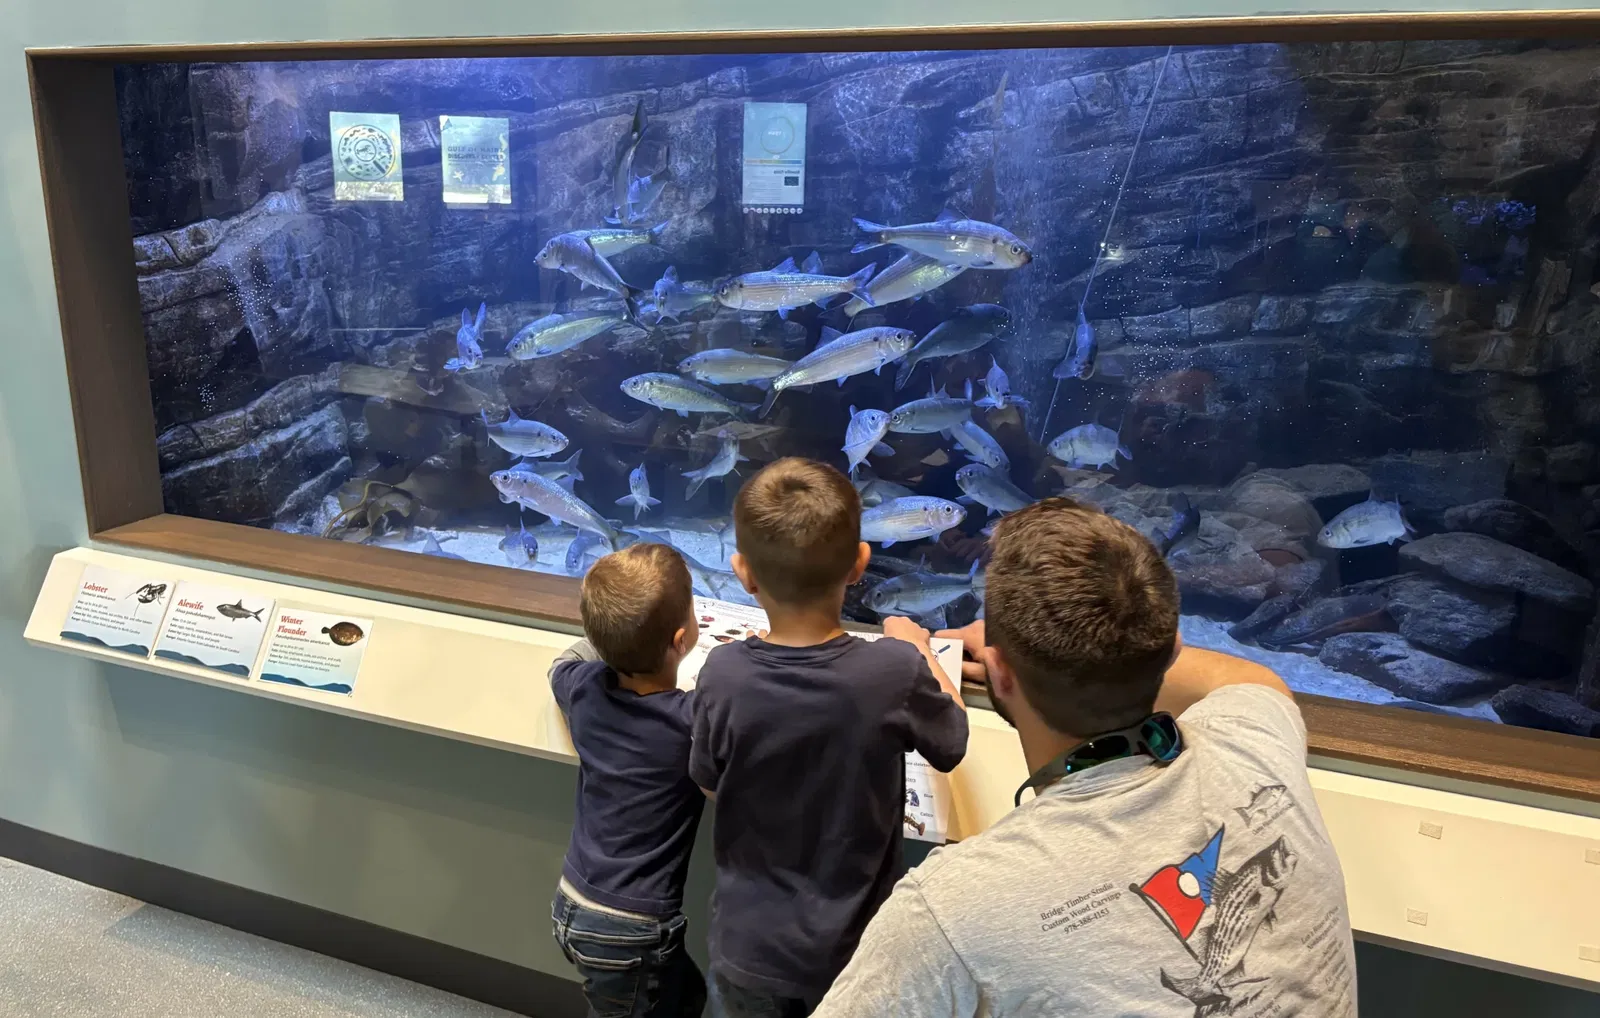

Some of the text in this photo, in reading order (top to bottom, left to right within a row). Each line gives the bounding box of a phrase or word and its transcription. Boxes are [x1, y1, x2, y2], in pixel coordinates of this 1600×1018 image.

[84, 582, 108, 594] Lobster
[178, 599, 204, 610] Alewife
[280, 616, 304, 624] Winter
[277, 626, 307, 635] Flounder
[1040, 882, 1114, 920] Bridge Timber Studio
[1042, 892, 1122, 932] Custom Wood Carvings
